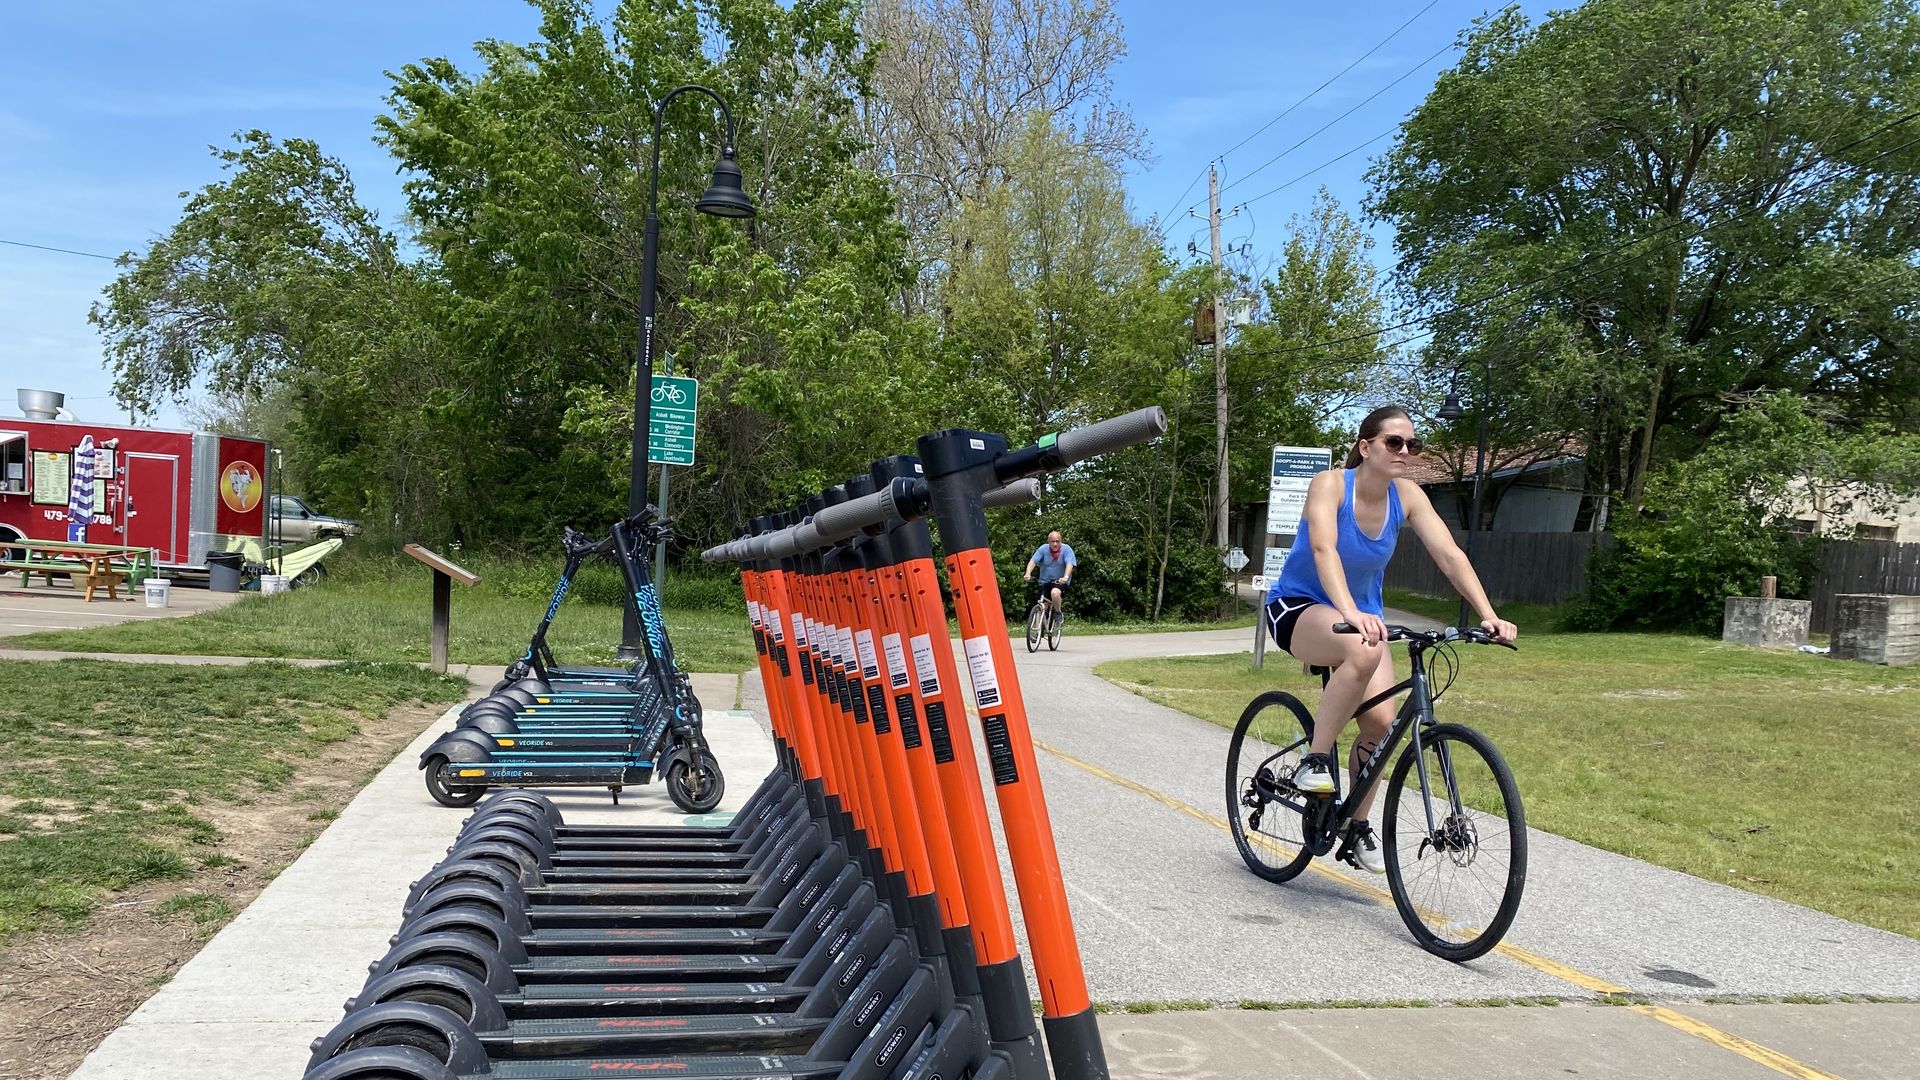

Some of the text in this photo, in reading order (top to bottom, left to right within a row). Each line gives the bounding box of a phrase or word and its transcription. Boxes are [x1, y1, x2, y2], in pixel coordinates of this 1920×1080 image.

[545, 578, 570, 622] VEORIDE
[635, 591, 662, 658] VEORIDE
[802, 883, 819, 904] SEGWAY
[817, 907, 835, 929] SEGWAY
[830, 930, 847, 955] SEGWAY
[843, 956, 862, 983] SEGWAY
[858, 994, 879, 1023] SEGWAY
[596, 1018, 689, 1027] SPIN
[880, 1029, 903, 1062] SEGWAY
[590, 1062, 688, 1070] SPIN
